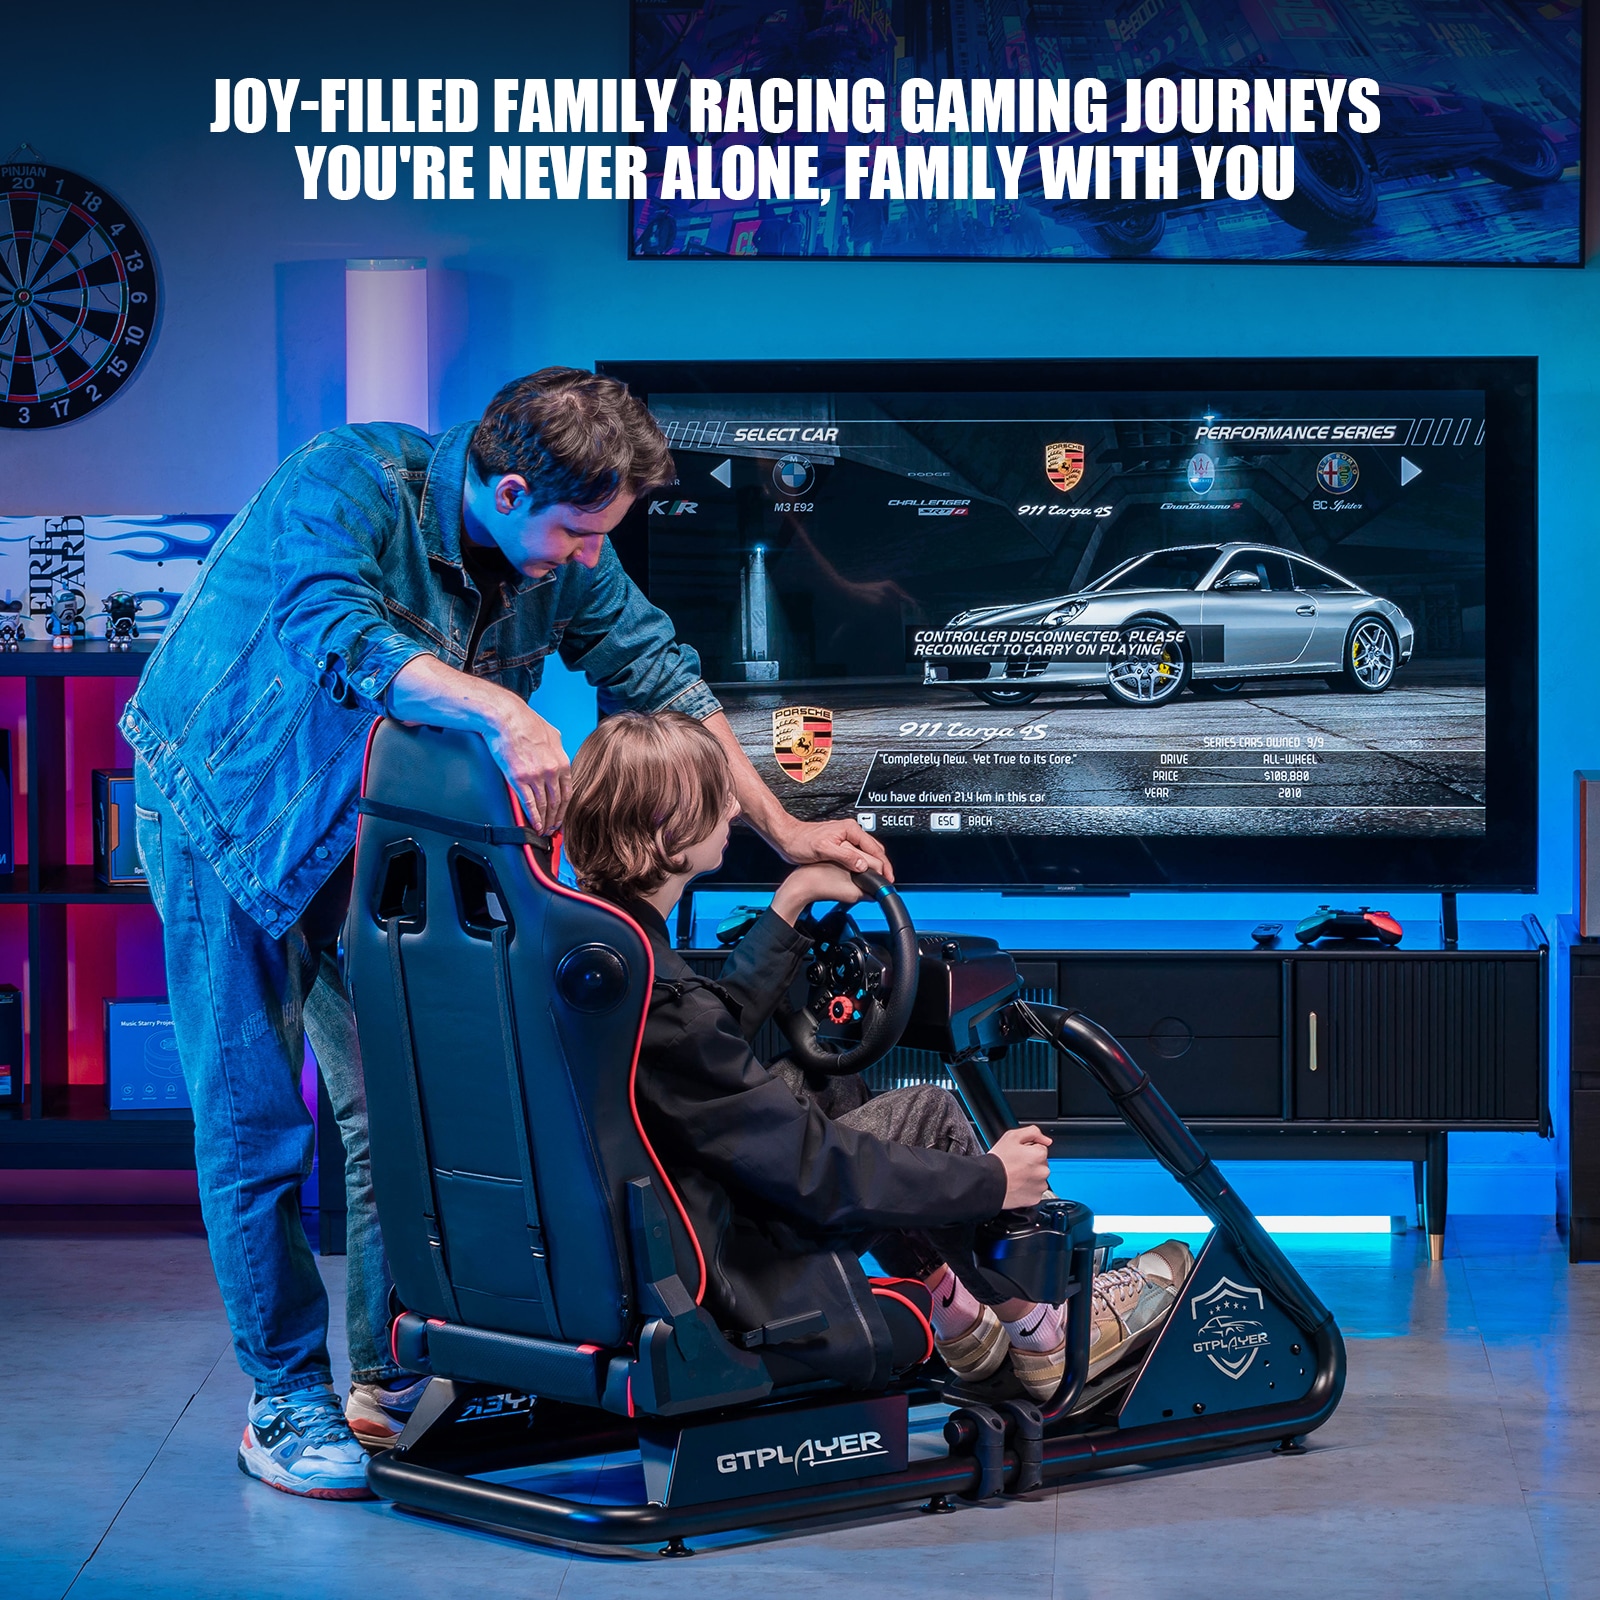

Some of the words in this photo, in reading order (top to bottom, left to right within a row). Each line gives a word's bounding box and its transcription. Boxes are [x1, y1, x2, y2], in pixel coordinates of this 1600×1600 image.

[1, 166, 47, 178] PINJIAN
[12, 177, 35, 190] 20
[54, 179, 65, 195] 1
[80, 190, 103, 213] 18
[109, 222, 127, 237] 4
[124, 249, 145, 272] 13
[130, 291, 148, 304] 9
[124, 325, 145, 347] 10
[106, 355, 128, 379] 15
[86, 384, 102, 403] 2
[50, 398, 71, 419] 17
[18, 407, 31, 424] 3
[734, 428, 801, 442] SELECT
[801, 428, 839, 442] CAR
[1194, 425, 1331, 441] PERFORMANCE
[1330, 425, 1397, 440] SERIES
[777, 455, 812, 470] BMW
[774, 503, 792, 513] M3
[793, 503, 814, 513] E92
[888, 499, 971, 507] CHALLENGER
[1160, 502, 1231, 510] GranTurismo
[1313, 500, 1328, 510] 8C
[1329, 499, 1363, 513] Spider
[1018, 505, 1049, 517] 911
[1049, 505, 1092, 518] Targa
[1093, 505, 1113, 518] 4S
[29, 535, 53, 616] FIRE
[914, 631, 1007, 643] CONTROLLER
[1129, 631, 1186, 643] PLEASE
[914, 644, 1000, 656] RECONNECT
[1003, 644, 1022, 656] TO
[1024, 644, 1072, 656] CARRY
[1075, 644, 1096, 656] ON
[1099, 644, 1164, 656] PLAYING.
[775, 708, 832, 720] PORSCHE
[899, 721, 940, 738] 911
[946, 721, 1015, 741] Targa
[1019, 723, 1049, 741] 4S
[1203, 737, 1236, 748] SERIES
[1239, 737, 1263, 748] CARS
[1266, 737, 1300, 748] OWNED
[1307, 737, 1324, 748] 9/9
[972, 753, 991, 765] Yet
[993, 753, 1015, 765] True
[1019, 754, 1030, 765] to
[1033, 753, 1047, 765] its
[1160, 754, 1189, 765] DRIVE
[1263, 754, 1318, 765] ALL-WHEEL
[1152, 771, 1179, 782] PRICE
[1263, 770, 1310, 782] $108,880
[868, 791, 888, 803] You
[890, 791, 916, 803] have
[918, 791, 951, 803] driven
[954, 792, 974, 803] 21.4
[976, 792, 992, 803] km
[995, 792, 1006, 802] in
[1007, 792, 1027, 803] this
[1029, 793, 1046, 803] car
[1145, 788, 1169, 798] YEAR
[1278, 788, 1302, 798] 2010
[881, 815, 915, 827] SELECT
[937, 815, 955, 827] ESC
[968, 815, 993, 827] BACK
[1193, 1332, 1269, 1354] GTPLAYER
[716, 1431, 884, 1475] GTPLAYER
